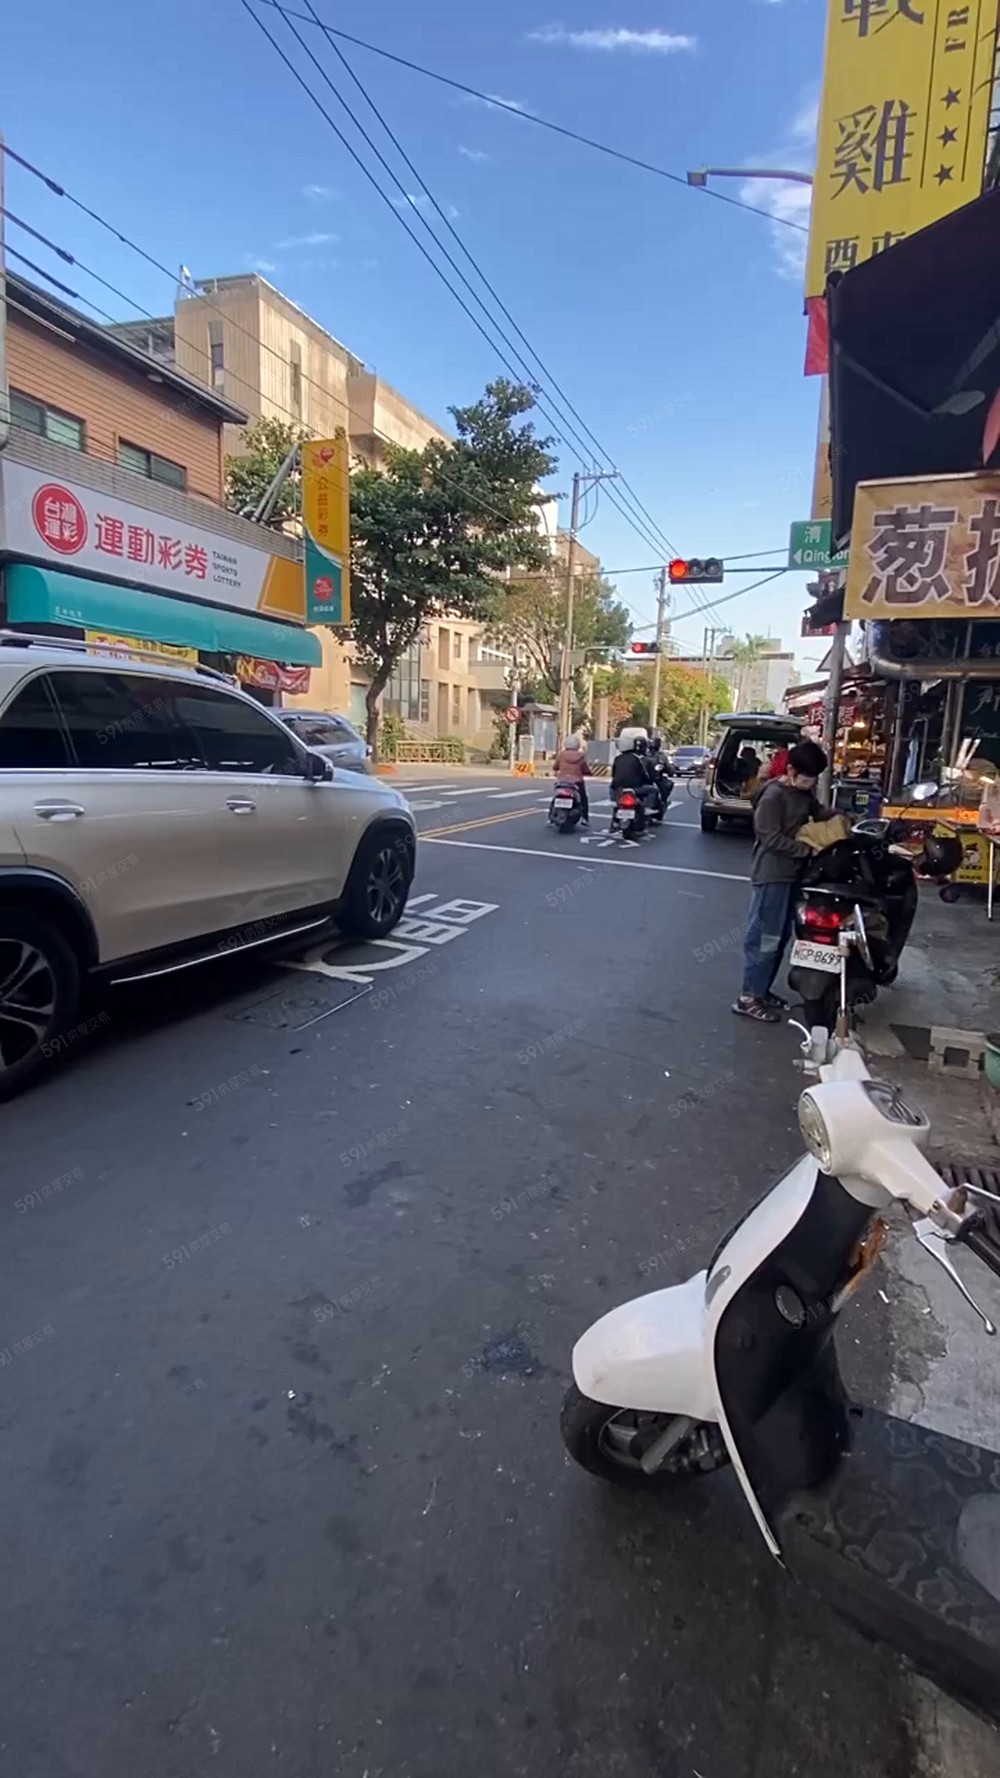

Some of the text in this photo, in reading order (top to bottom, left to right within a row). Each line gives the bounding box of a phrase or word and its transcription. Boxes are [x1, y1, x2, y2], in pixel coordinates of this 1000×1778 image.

[94, 513, 209, 580] 運動彩券
[213, 550, 238, 565] TAIWAN
[213, 562, 239, 577] SPORTS
[213, 575, 242, 588] LOTTERY
